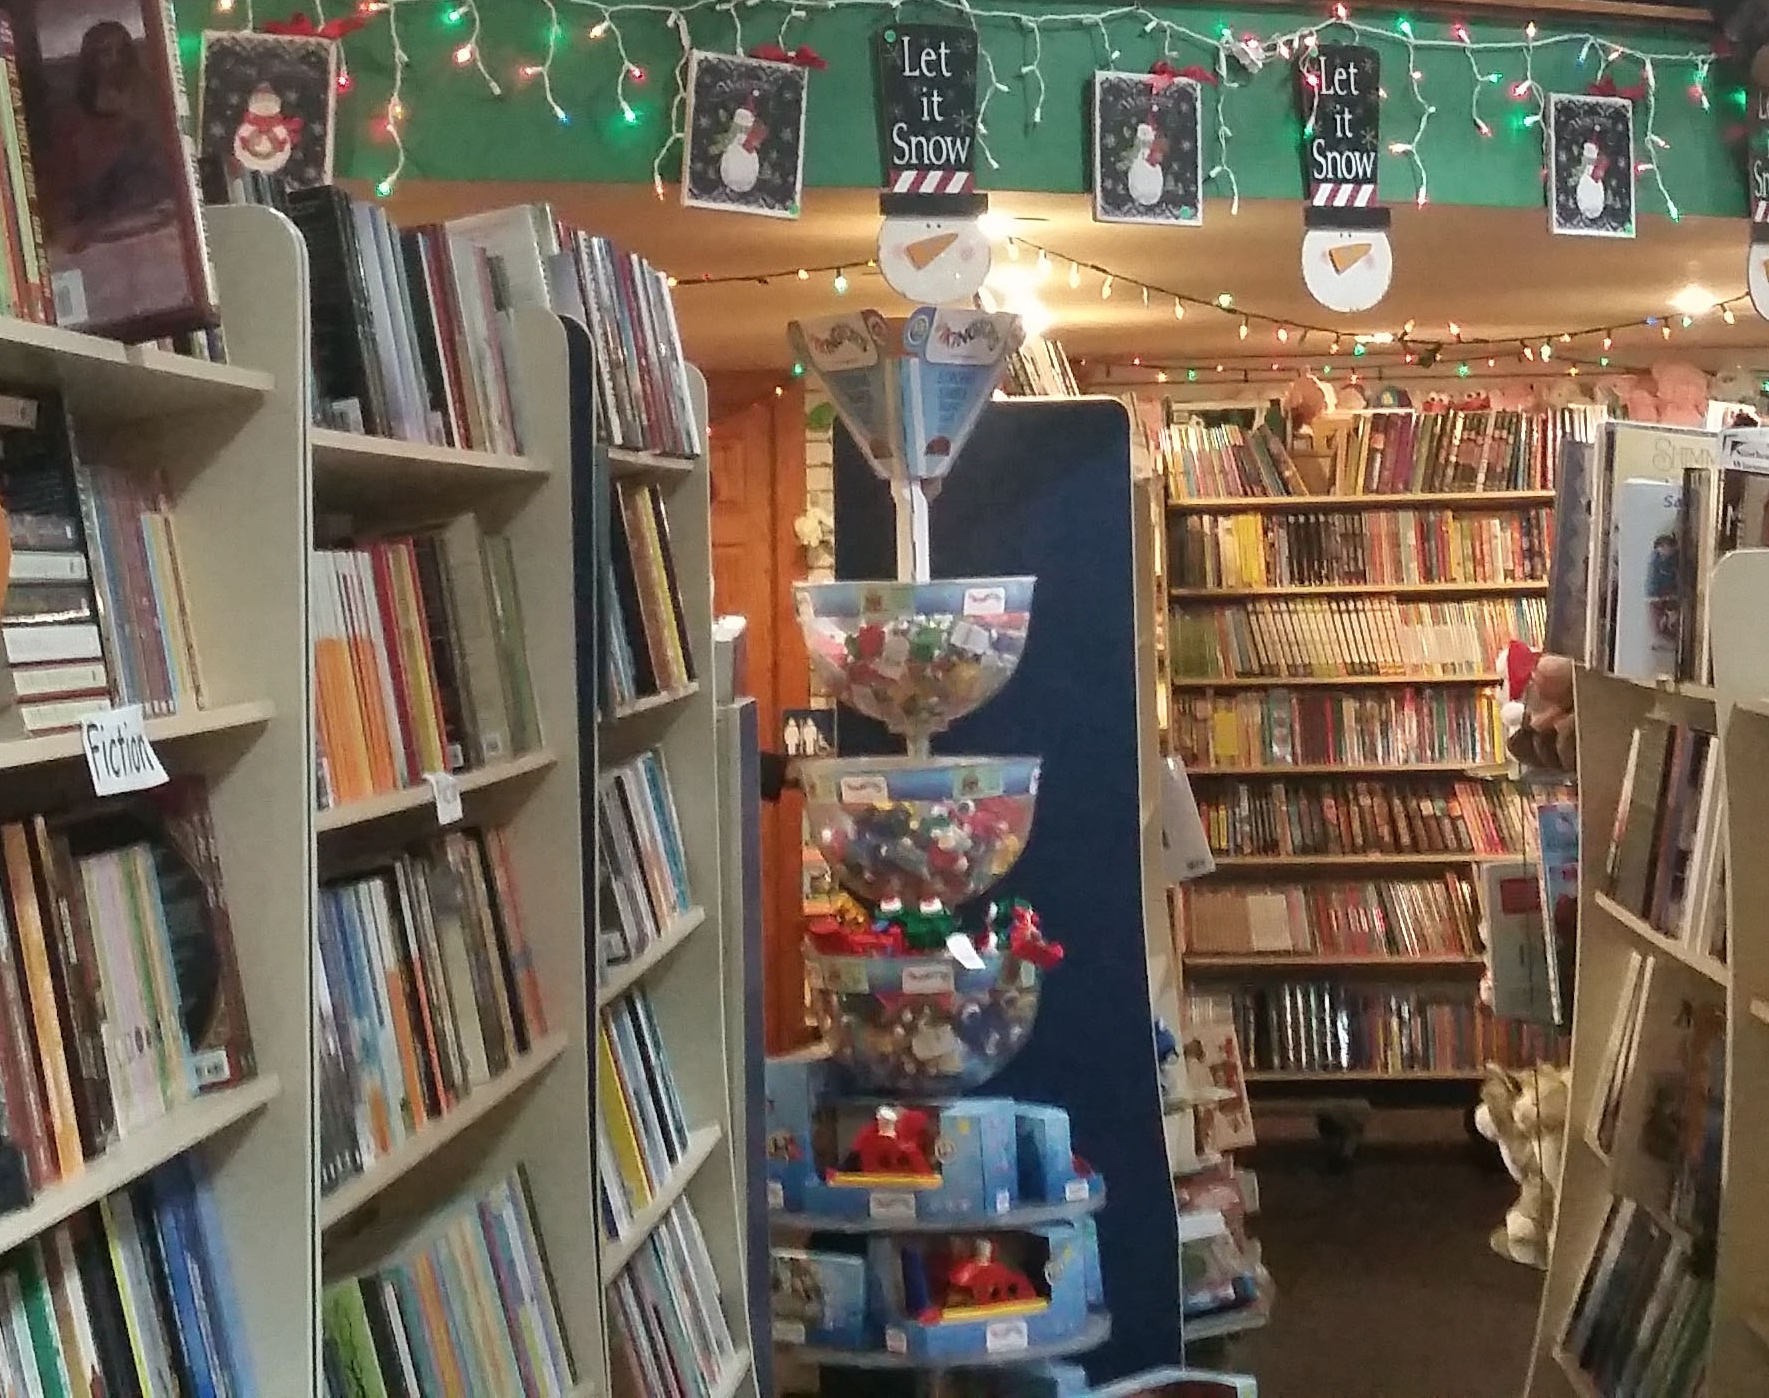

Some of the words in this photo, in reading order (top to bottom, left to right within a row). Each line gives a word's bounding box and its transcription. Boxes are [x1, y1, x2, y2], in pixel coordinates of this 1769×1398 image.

[901, 37, 952, 78] Let
[1320, 56, 1359, 96] Let
[920, 87, 944, 121] it
[1333, 105, 1353, 139] it
[892, 123, 972, 166] Snow
[1313, 139, 1376, 179] Snow
[87, 721, 155, 782] Fiction
